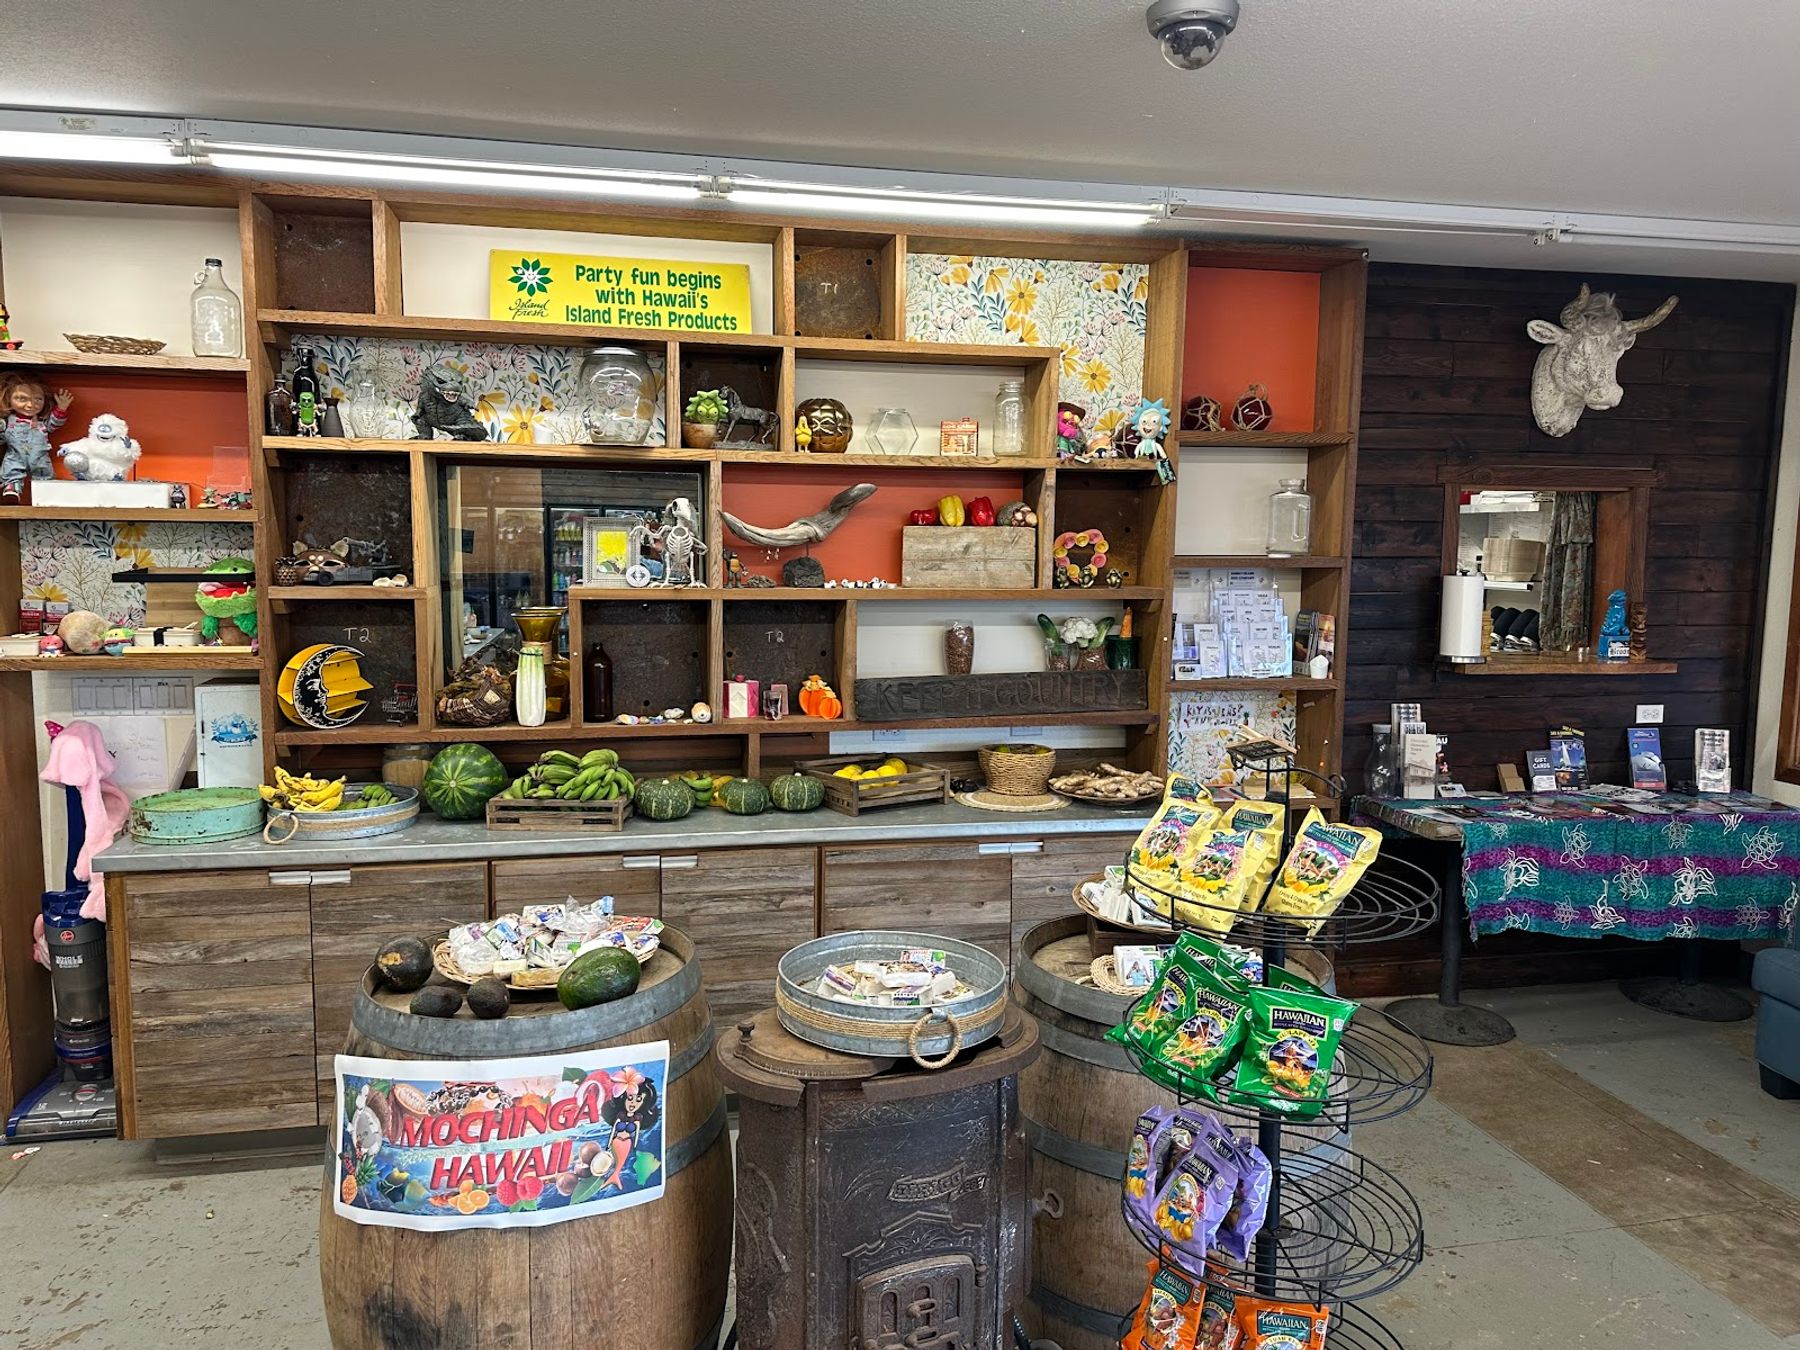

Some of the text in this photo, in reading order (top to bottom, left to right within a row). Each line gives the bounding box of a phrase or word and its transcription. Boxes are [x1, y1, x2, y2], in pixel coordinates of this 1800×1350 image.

[576, 264, 722, 291] Party fun begins
[509, 298, 550, 311] Island
[595, 287, 708, 309] with Hawaii's
[512, 308, 549, 320] Fresh
[566, 305, 737, 331] Island Fresh Products
[342, 627, 371, 643] T2
[876, 682, 956, 713] KEEP
[993, 673, 1128, 708] COUNTRY
[1274, 1010, 1325, 1026] HAWAIIAN
[402, 1092, 600, 1146] MOCHINGA
[430, 1140, 574, 1191] HAWAII
[1263, 1316, 1307, 1329] HAWAIIAN
